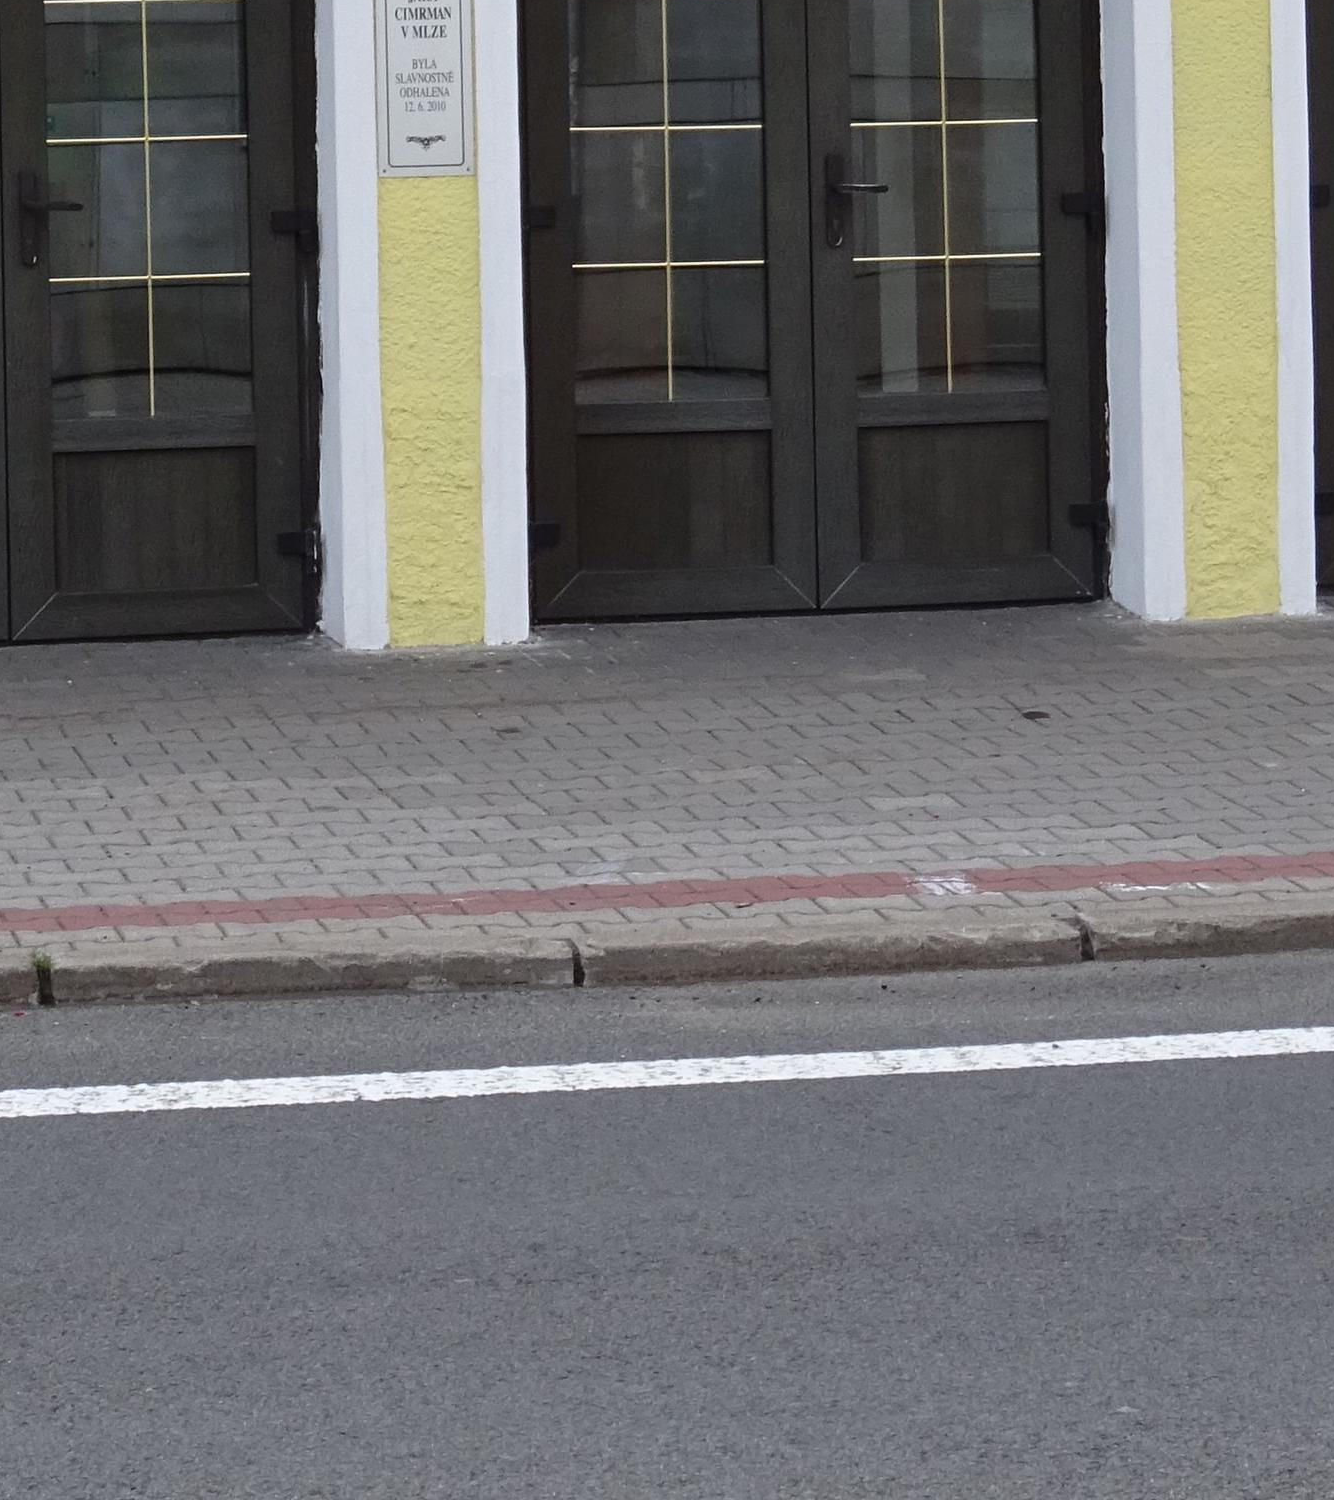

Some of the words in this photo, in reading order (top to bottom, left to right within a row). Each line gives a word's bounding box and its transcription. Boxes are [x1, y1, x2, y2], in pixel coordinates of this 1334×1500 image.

[395, 6, 452, 21] CIMRMAN
[401, 26, 409, 39] V
[412, 25, 448, 39] MLZE
[412, 58, 437, 70] BYLA
[399, 86, 450, 98] ODHALENA
[427, 101, 447, 112] 2010
